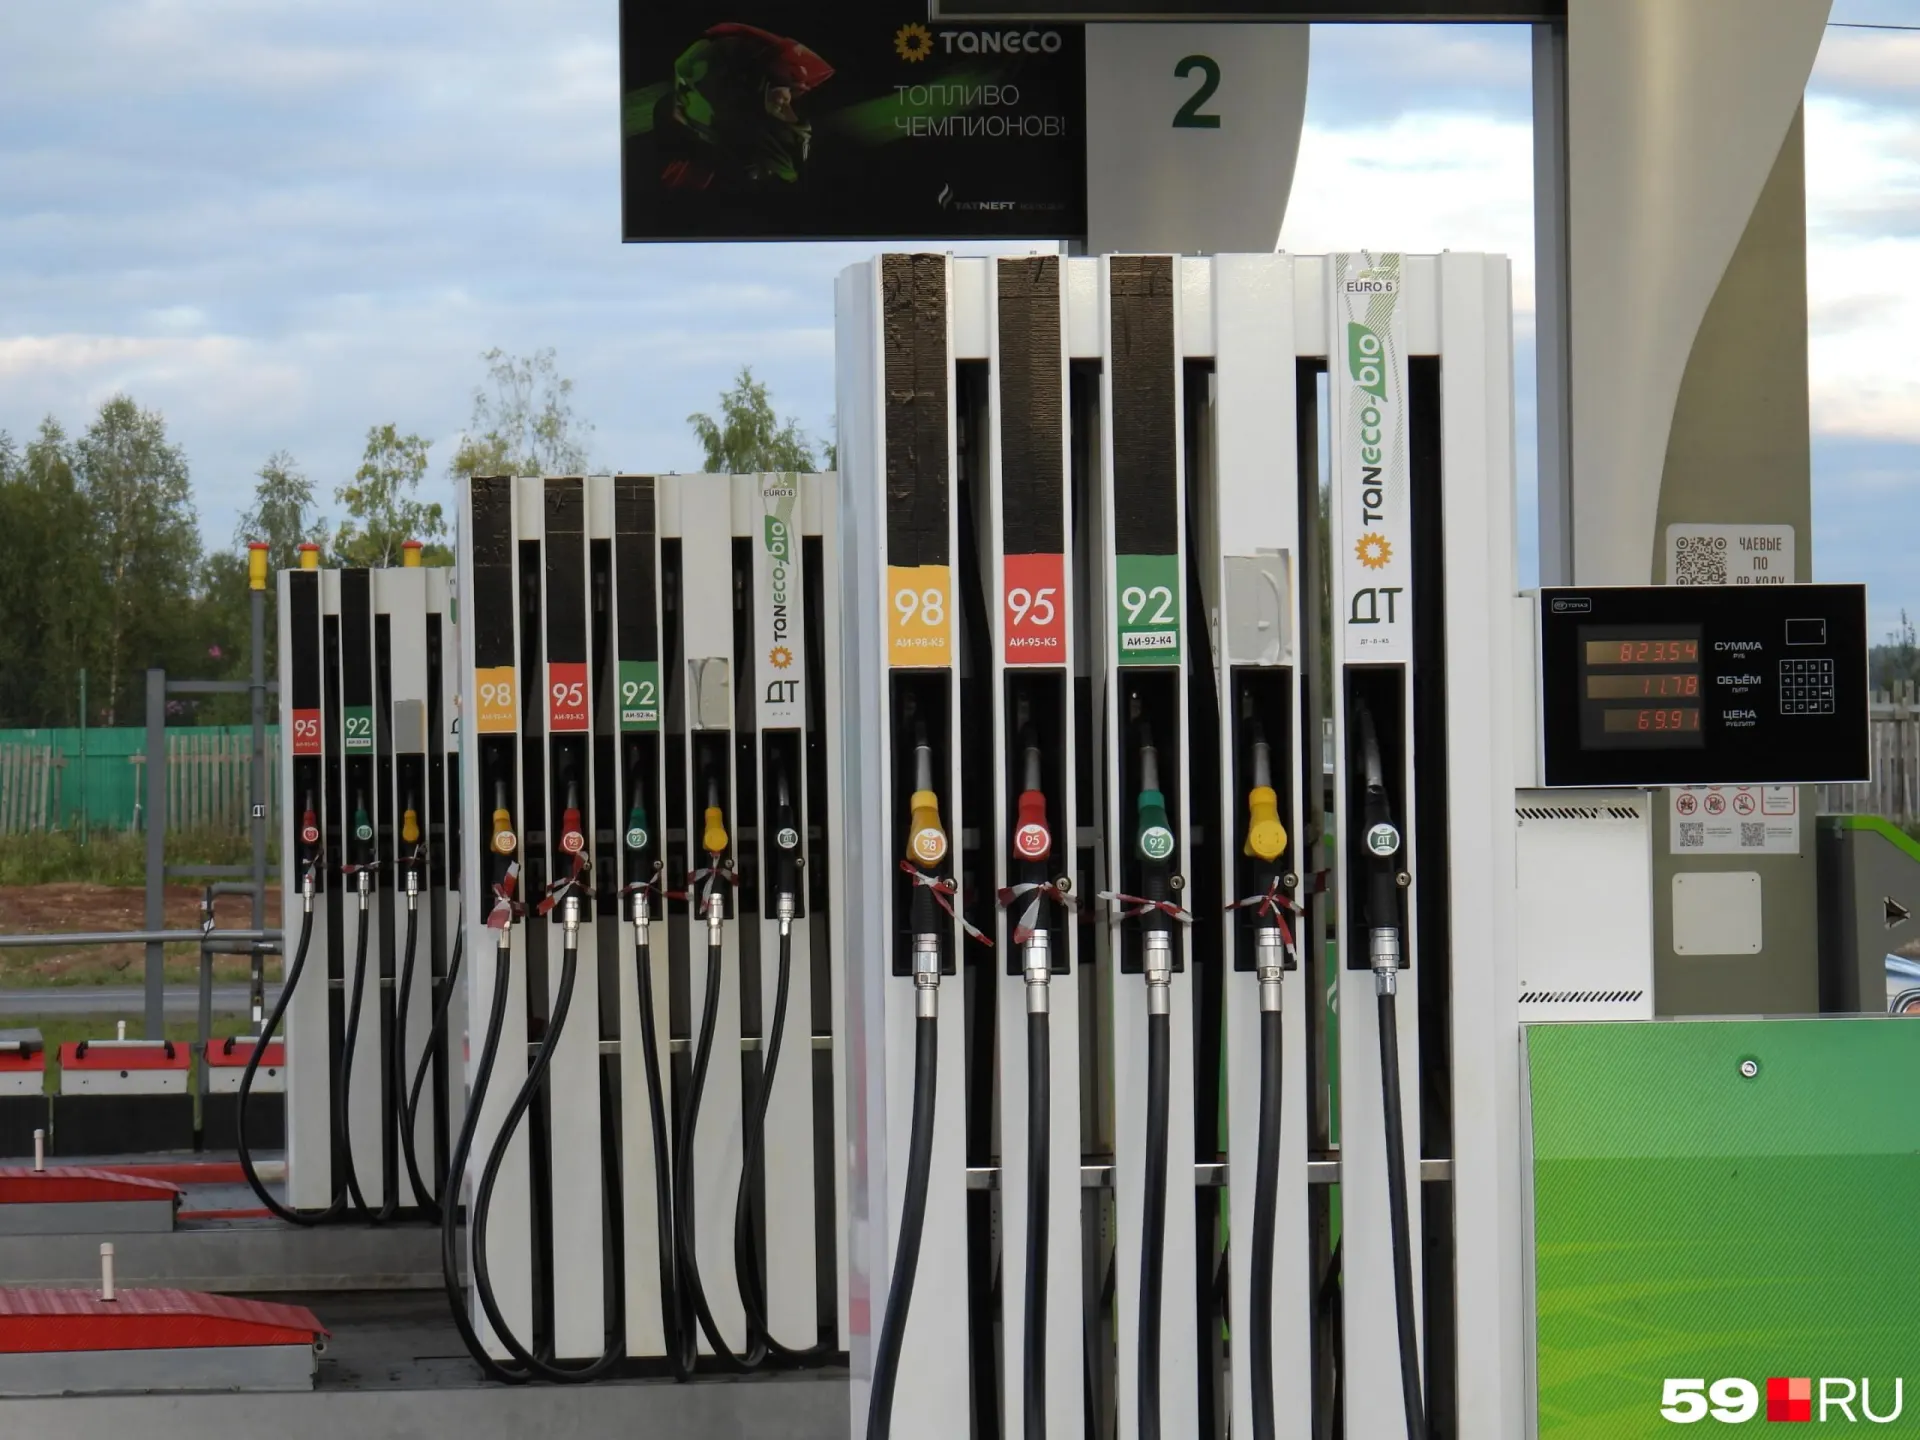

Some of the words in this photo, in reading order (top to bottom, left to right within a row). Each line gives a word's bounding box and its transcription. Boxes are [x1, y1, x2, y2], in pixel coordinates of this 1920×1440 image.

[893, 84, 1020, 106] ТОПЛИВО
[1172, 54, 1221, 129] 2
[894, 115, 1066, 137] ЧЕМПИОНОВ!
[954, 201, 1016, 210] TATNEFT
[1346, 281, 1382, 292] EURO
[1385, 281, 1393, 292] 6
[763, 489, 786, 497] EURO
[788, 489, 793, 497] 6
[1739, 537, 1782, 551] ЧАЕВЫЕ
[1753, 556, 1768, 570] ПО
[894, 588, 945, 626] 98
[1007, 588, 1057, 626] 95
[1121, 586, 1175, 625] 92
[1348, 587, 1404, 625] ДТ
[895, 637, 945, 648] АИ-98-К5
[1009, 637, 1057, 647] АИ-95-К5
[1127, 635, 1172, 647] АИ-92-К4
[1714, 641, 1763, 651] СУММА
[1620, 642, 1697, 662] 823.54
[1642, 675, 1698, 695] 11.78
[1716, 673, 1762, 685] ОБЪЁМ
[480, 682, 512, 707] 98
[552, 682, 584, 707] 95
[622, 681, 656, 705] 92
[765, 680, 800, 703] ДТ
[1637, 710, 1699, 730] 69.91
[1723, 709, 1757, 720] ЦЕНА
[295, 719, 318, 737] 95
[346, 718, 371, 735] 92
[252, 804, 265, 817] ДТ
[568, 837, 579, 846] 95
[631, 833, 642, 843] 92
[922, 839, 937, 851] 98
[1025, 834, 1040, 846] 95
[1149, 837, 1165, 849] 92
[1376, 834, 1392, 845] ДТ
